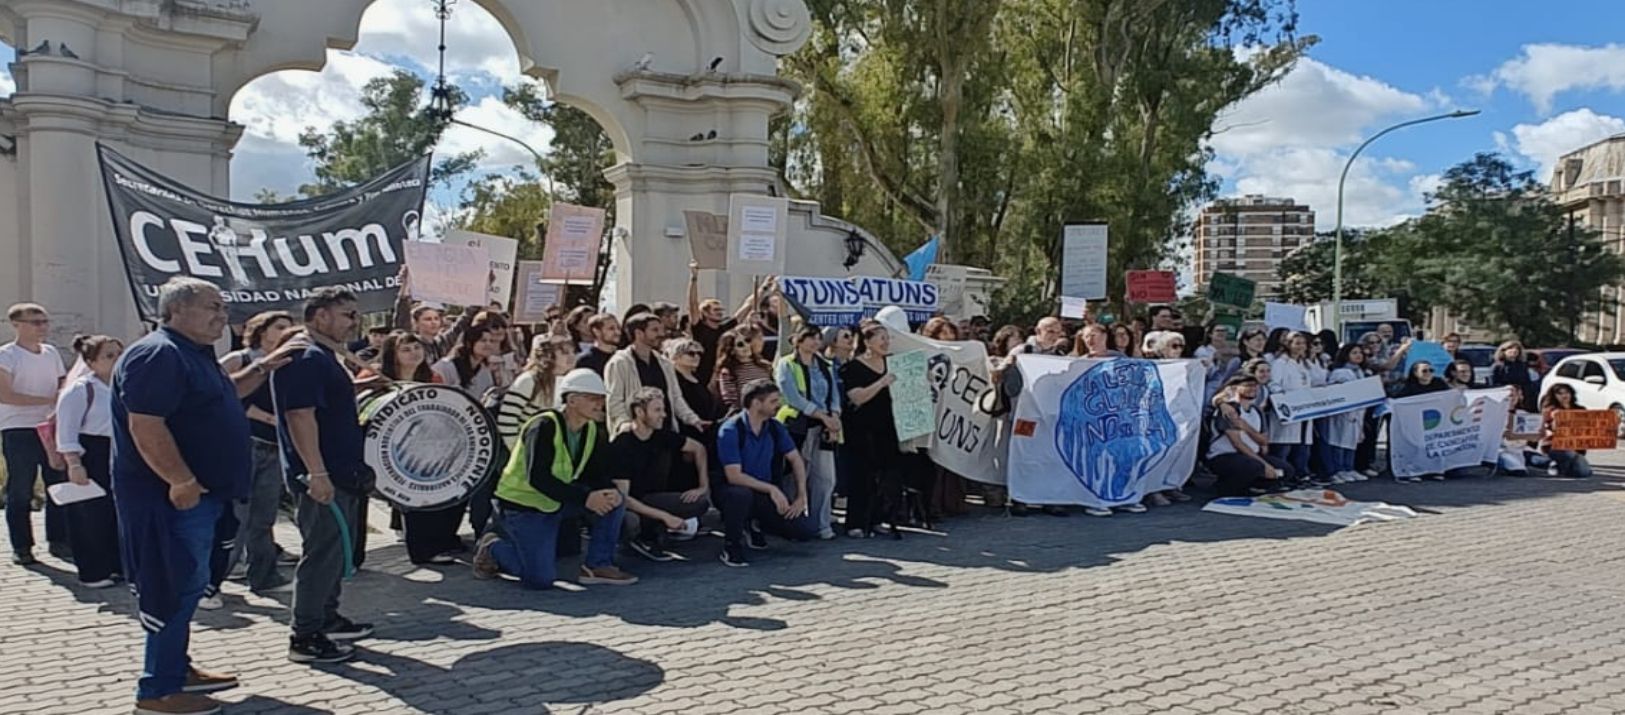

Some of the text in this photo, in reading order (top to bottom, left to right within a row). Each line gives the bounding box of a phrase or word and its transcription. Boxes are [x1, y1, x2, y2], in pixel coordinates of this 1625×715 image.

[145, 284, 281, 303] USIDAD
[285, 277, 384, 302] NANAL
[784, 278, 860, 305] ATUNS
[859, 277, 937, 306] ATUNS
[367, 389, 437, 440] SINDICATO
[938, 407, 980, 453] UNS
[461, 405, 490, 492] NODOCENTE
